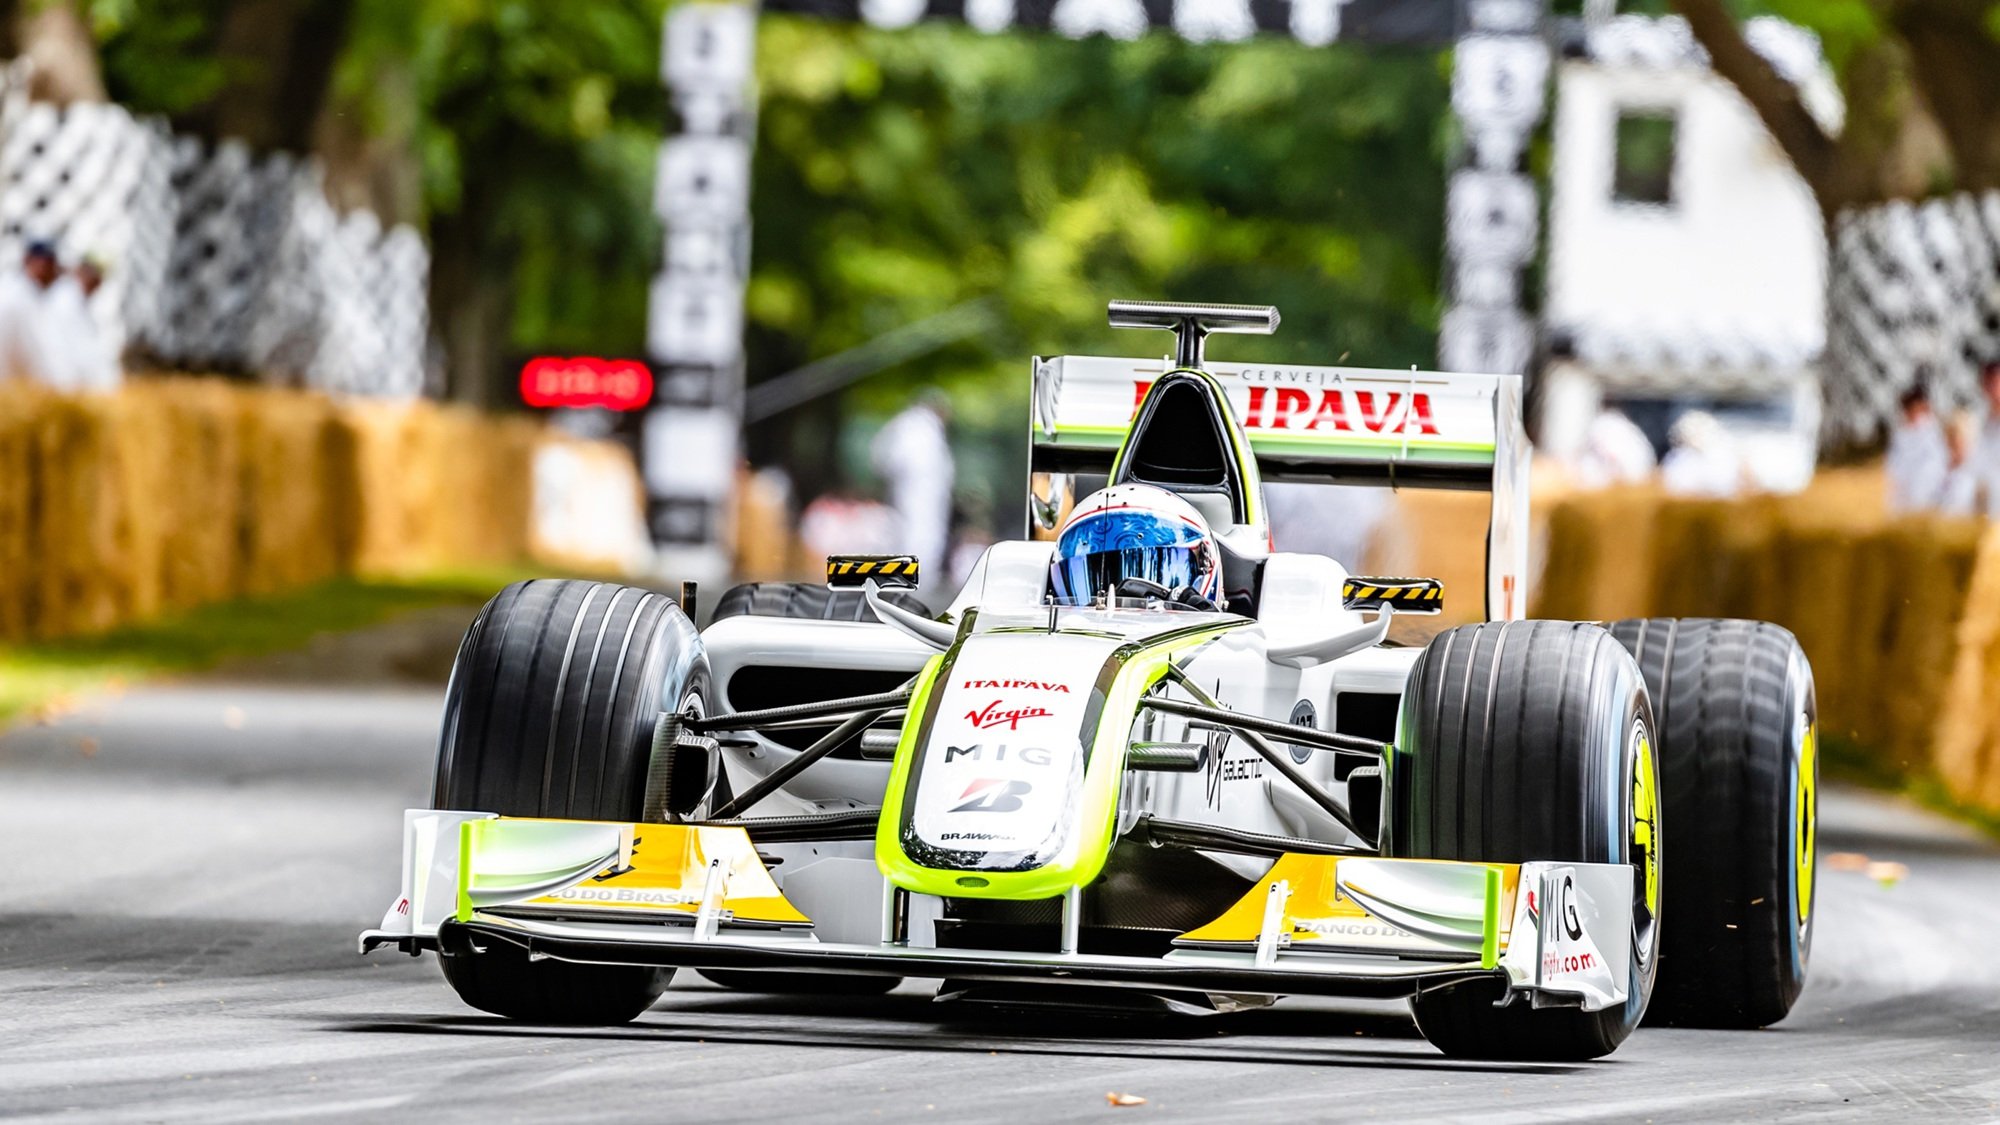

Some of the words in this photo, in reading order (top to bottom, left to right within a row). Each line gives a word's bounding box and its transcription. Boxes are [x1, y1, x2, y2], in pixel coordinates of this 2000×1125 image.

[1241, 369, 1342, 384] CERVEJA
[963, 679, 1070, 693] ITAIPAVA
[964, 700, 1054, 730] Virgin
[945, 744, 1052, 766] MIG
[581, 889, 613, 901] DO
[616, 889, 699, 906] BRASIL
[1544, 875, 1583, 942] MIG
[1294, 922, 1378, 937] BANCO
